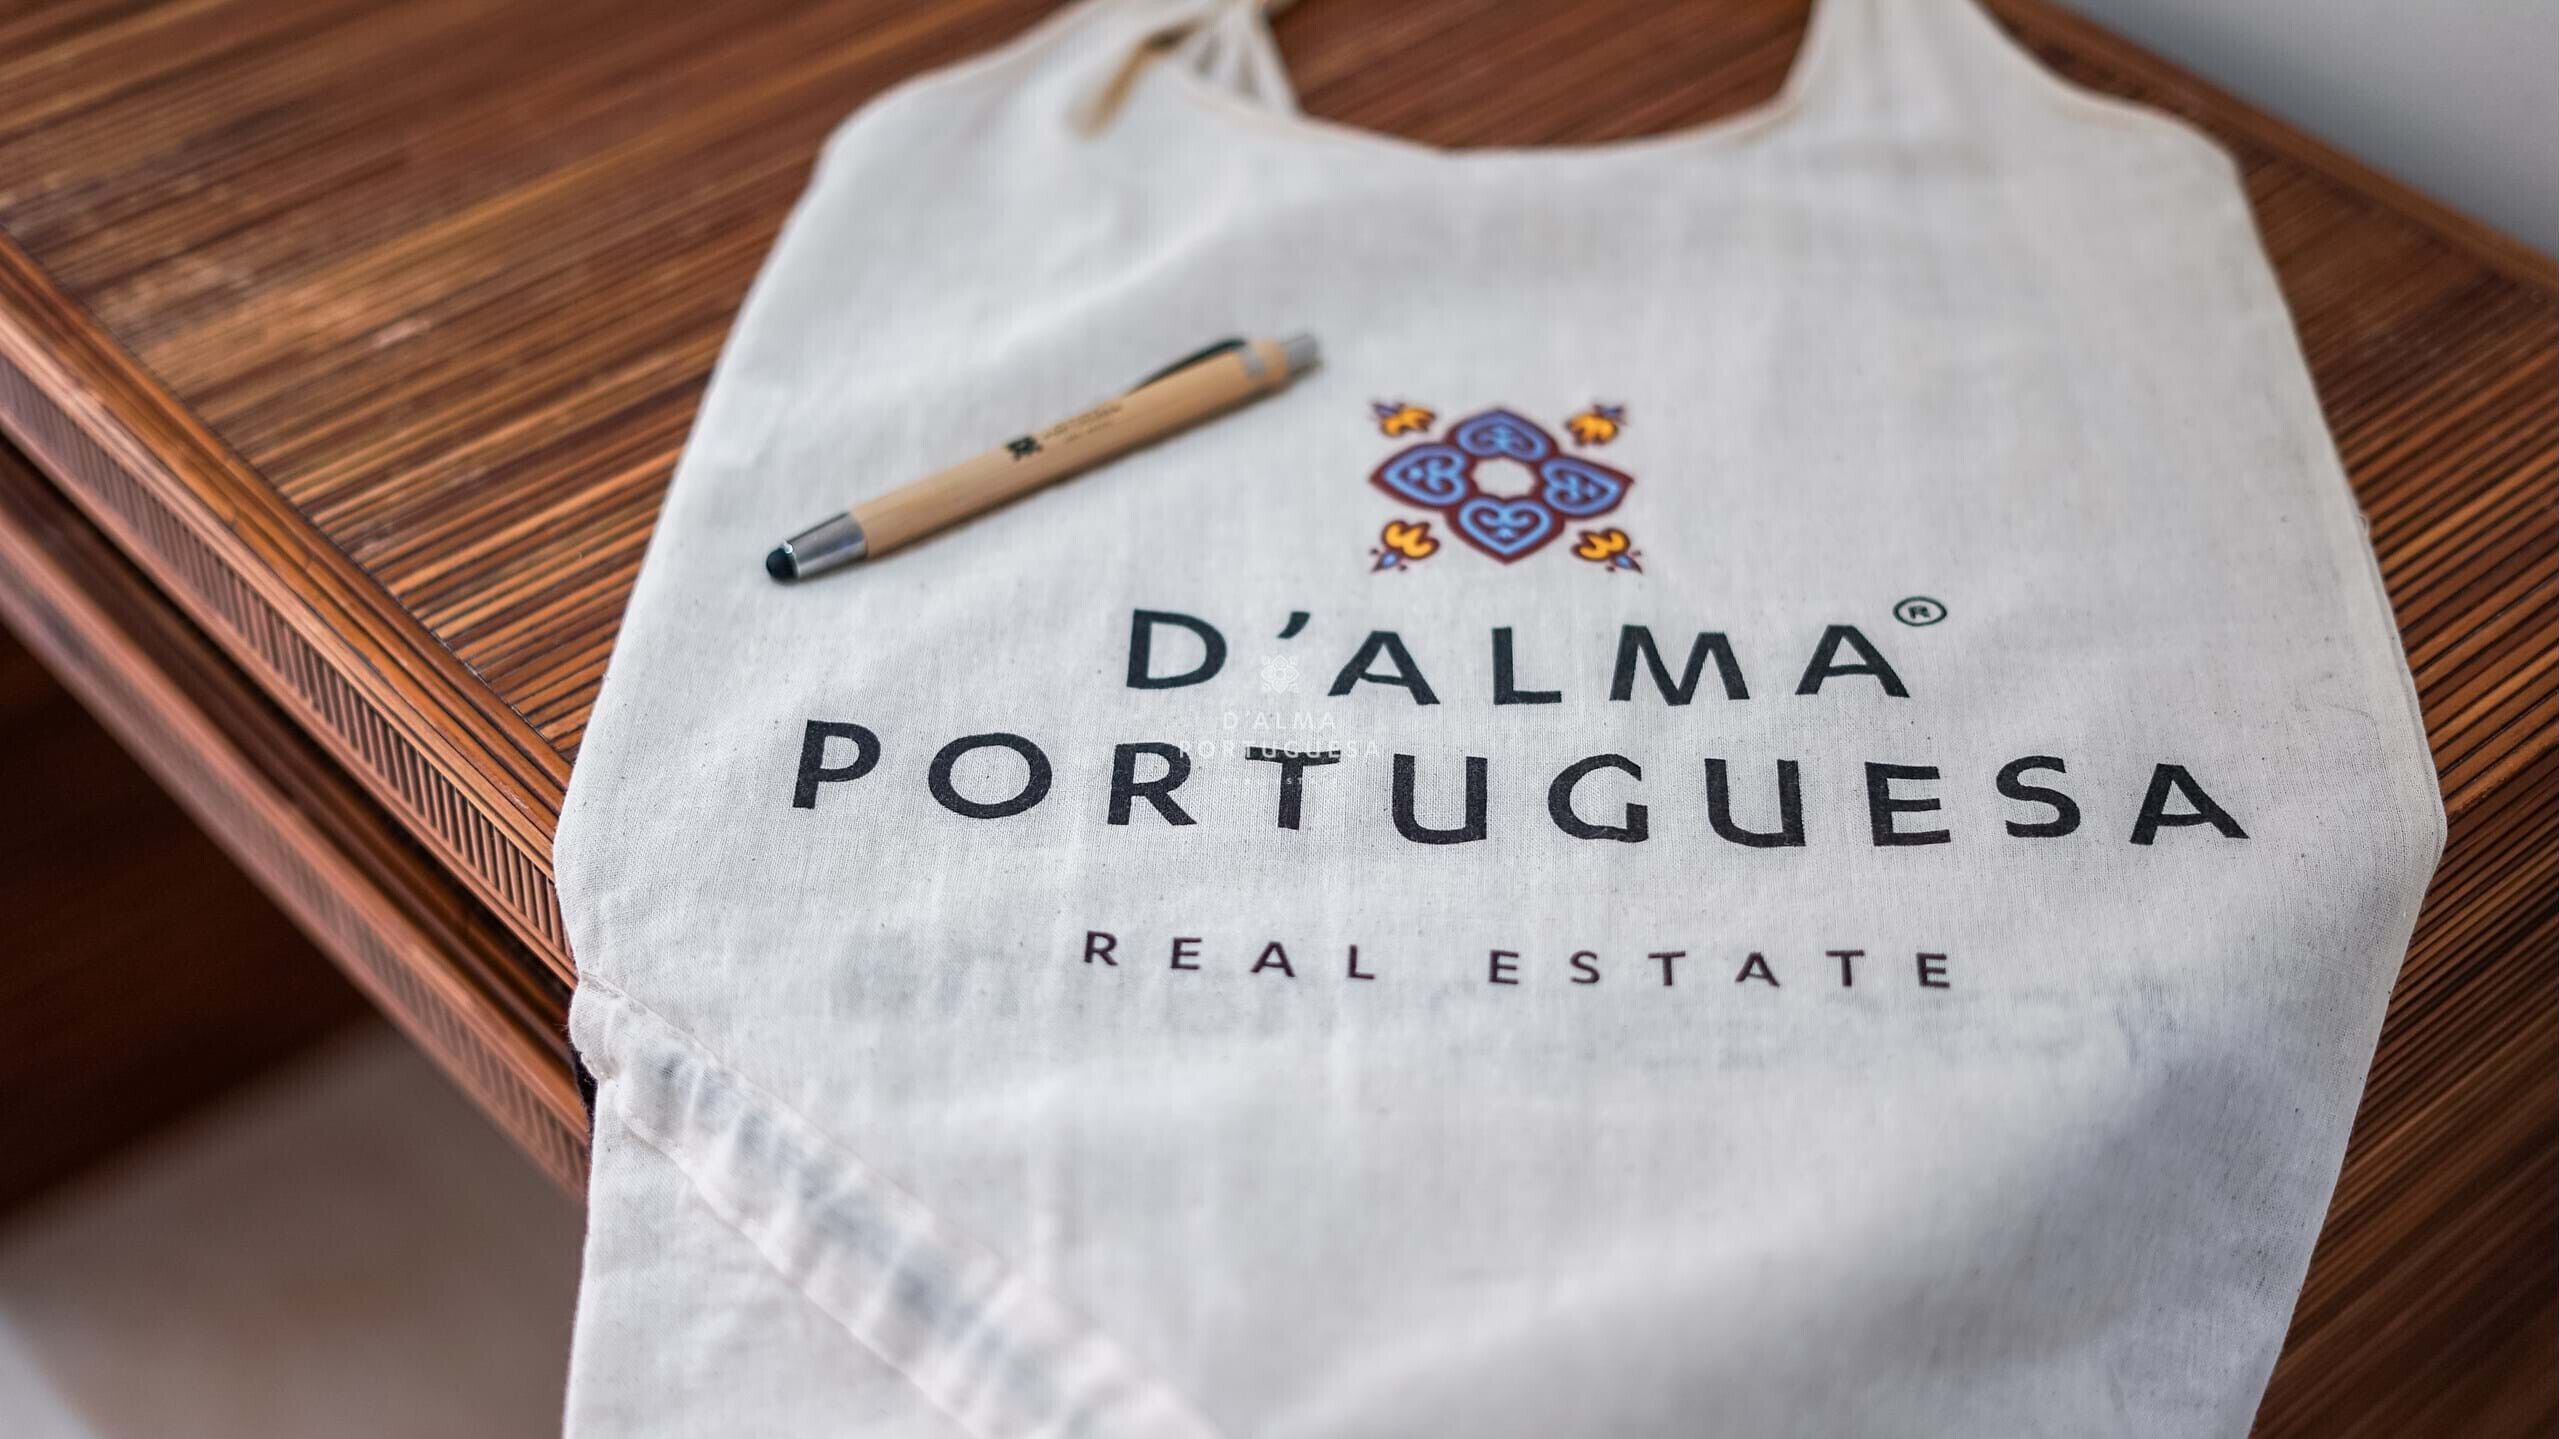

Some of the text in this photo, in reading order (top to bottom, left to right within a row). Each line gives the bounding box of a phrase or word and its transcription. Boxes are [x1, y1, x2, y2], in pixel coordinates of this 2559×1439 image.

[792, 720, 2251, 850] PORTUGUESA
[1083, 930, 1951, 990] REAL ESTATE
